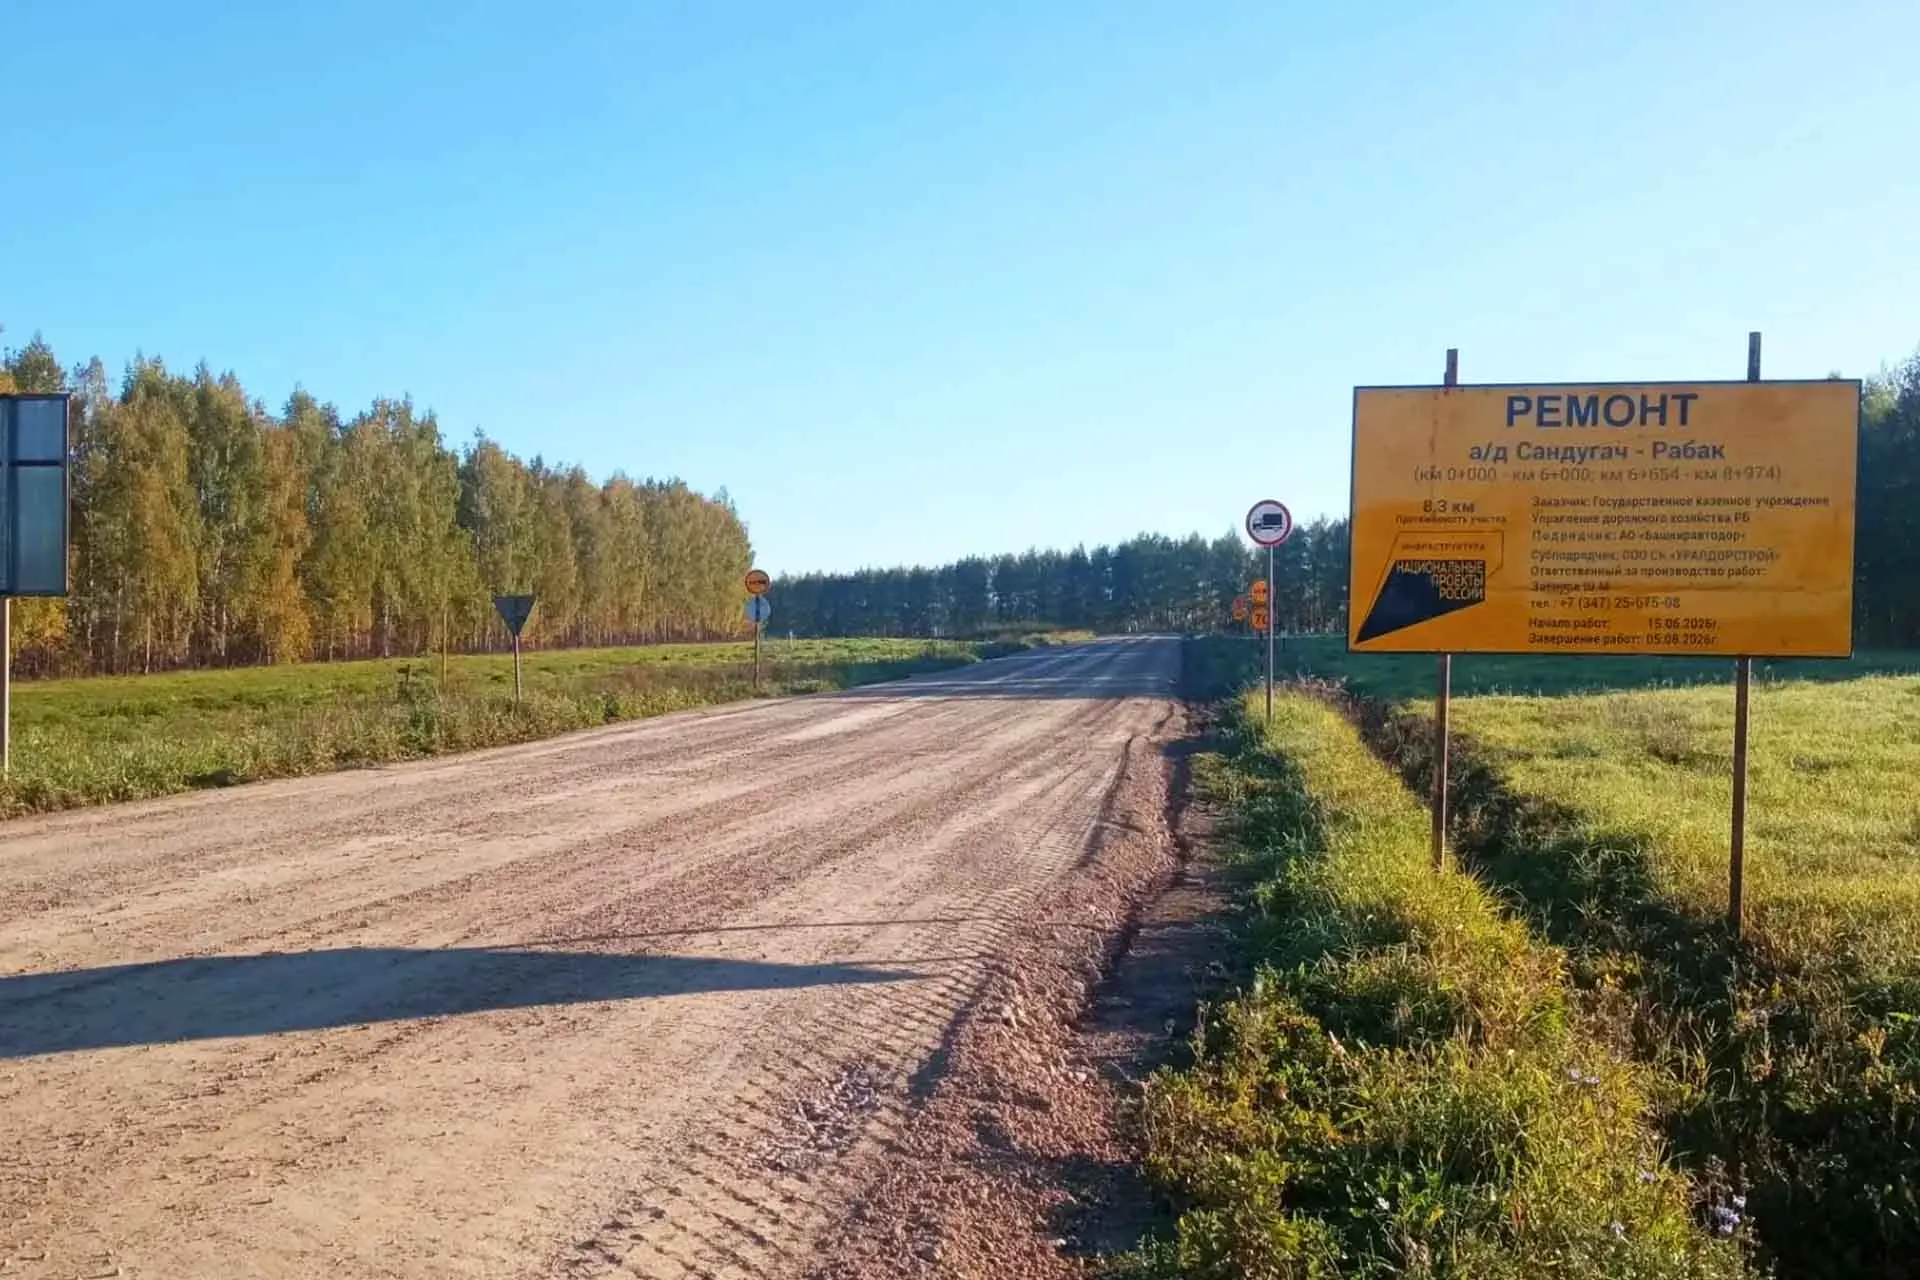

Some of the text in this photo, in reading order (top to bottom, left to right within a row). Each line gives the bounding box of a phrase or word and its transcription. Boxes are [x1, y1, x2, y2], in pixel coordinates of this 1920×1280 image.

[1507, 393, 1699, 427] РЕМОНТ
[1469, 441, 1508, 464] а/д
[1517, 440, 1628, 465] Сандугач
[1652, 440, 1725, 460] Рабак
[1447, 466, 1497, 481] 0+000
[1513, 471, 1535, 481] км
[1601, 470, 1623, 482] км
[1694, 470, 1717, 481] км
[1452, 502, 1475, 513] км
[1593, 496, 1692, 509] Государственное
[1696, 496, 1751, 506] казенное
[1756, 496, 1830, 508] учреждение
[1532, 512, 1599, 526] Управление
[1734, 511, 1750, 522] РБ
[1619, 530, 1636, 540] АО
[1622, 549, 1647, 560] ООО
[1396, 561, 1484, 575] НАЦИОНАЛЬНЫЕ
[1530, 565, 1622, 576] Ответственный
[1625, 567, 1638, 576] за
[1640, 567, 1725, 578] производство
[1431, 574, 1484, 588] ПРОЕКТЫ
[1439, 587, 1484, 600] РОССИИ
[1579, 596, 1611, 611] (347)
[1528, 618, 1571, 629] Начало
[1528, 632, 1600, 645] Завершение
